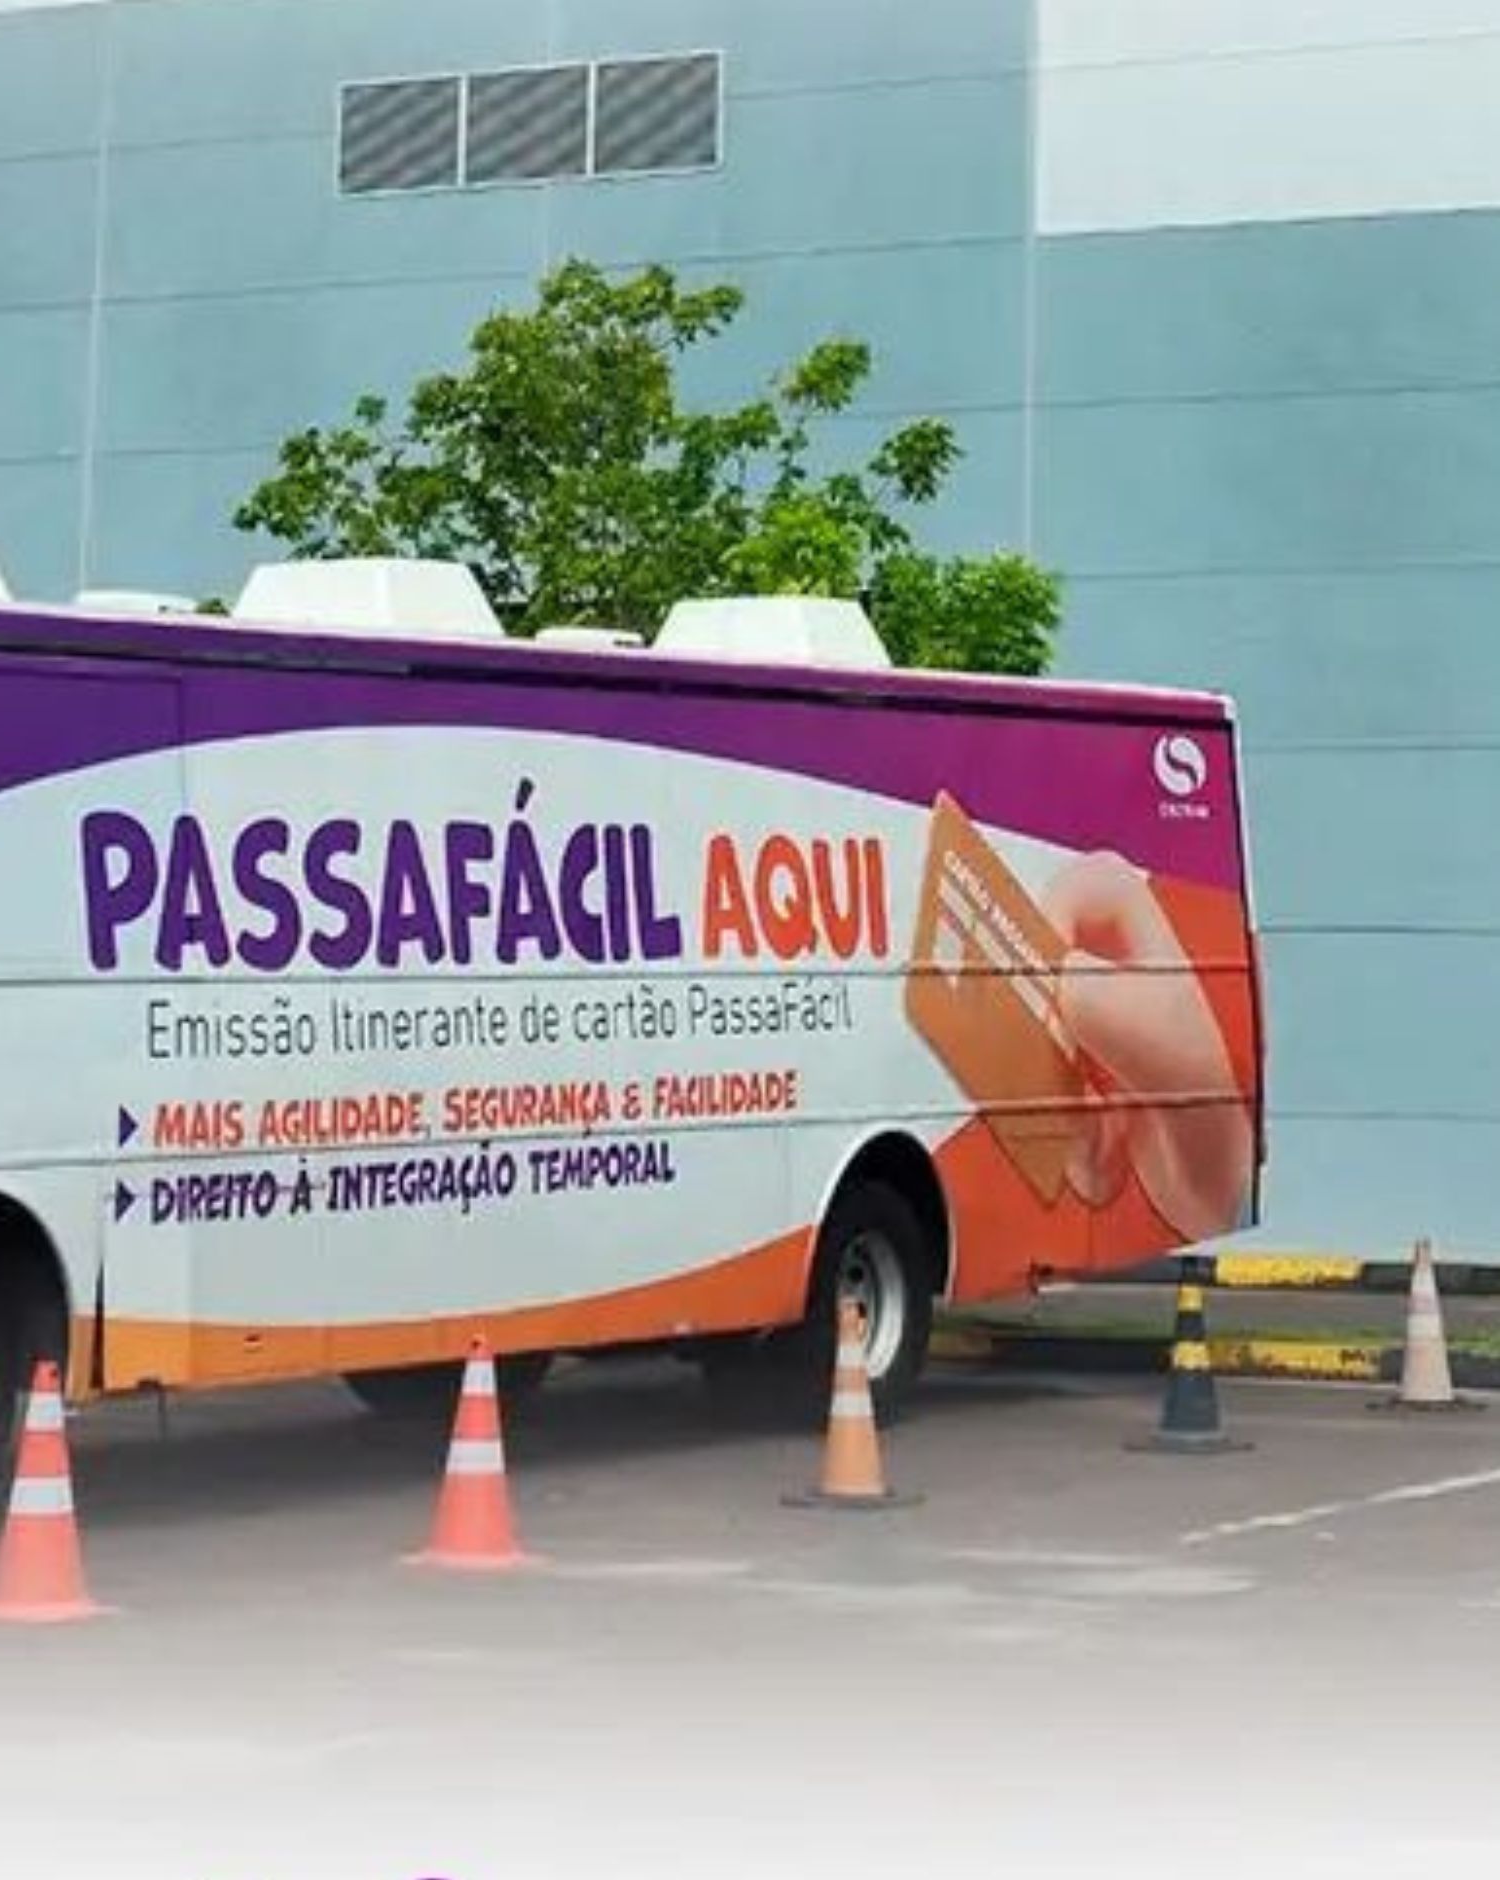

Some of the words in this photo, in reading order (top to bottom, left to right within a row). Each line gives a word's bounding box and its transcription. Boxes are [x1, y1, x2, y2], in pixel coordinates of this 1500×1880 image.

[80, 778, 682, 970] PASSAFÁCIL
[704, 835, 888, 960] AQUI
[148, 998, 317, 1060] Emissão
[331, 992, 507, 1051] Itinerante
[519, 998, 562, 1044] de
[574, 985, 679, 1040] cartão
[687, 973, 855, 1035] PassaFácil
[153, 1101, 247, 1149] MAIS
[258, 1091, 434, 1145] AGILIDADE,
[441, 1079, 611, 1139] SEGURANÇA
[621, 1080, 642, 1120] &
[652, 1070, 800, 1117] FACILIDADE
[150, 1171, 278, 1225] DIREITO
[327, 1141, 515, 1213] INTEGRAÇÃO
[528, 1140, 677, 1195] TEMPORAL
